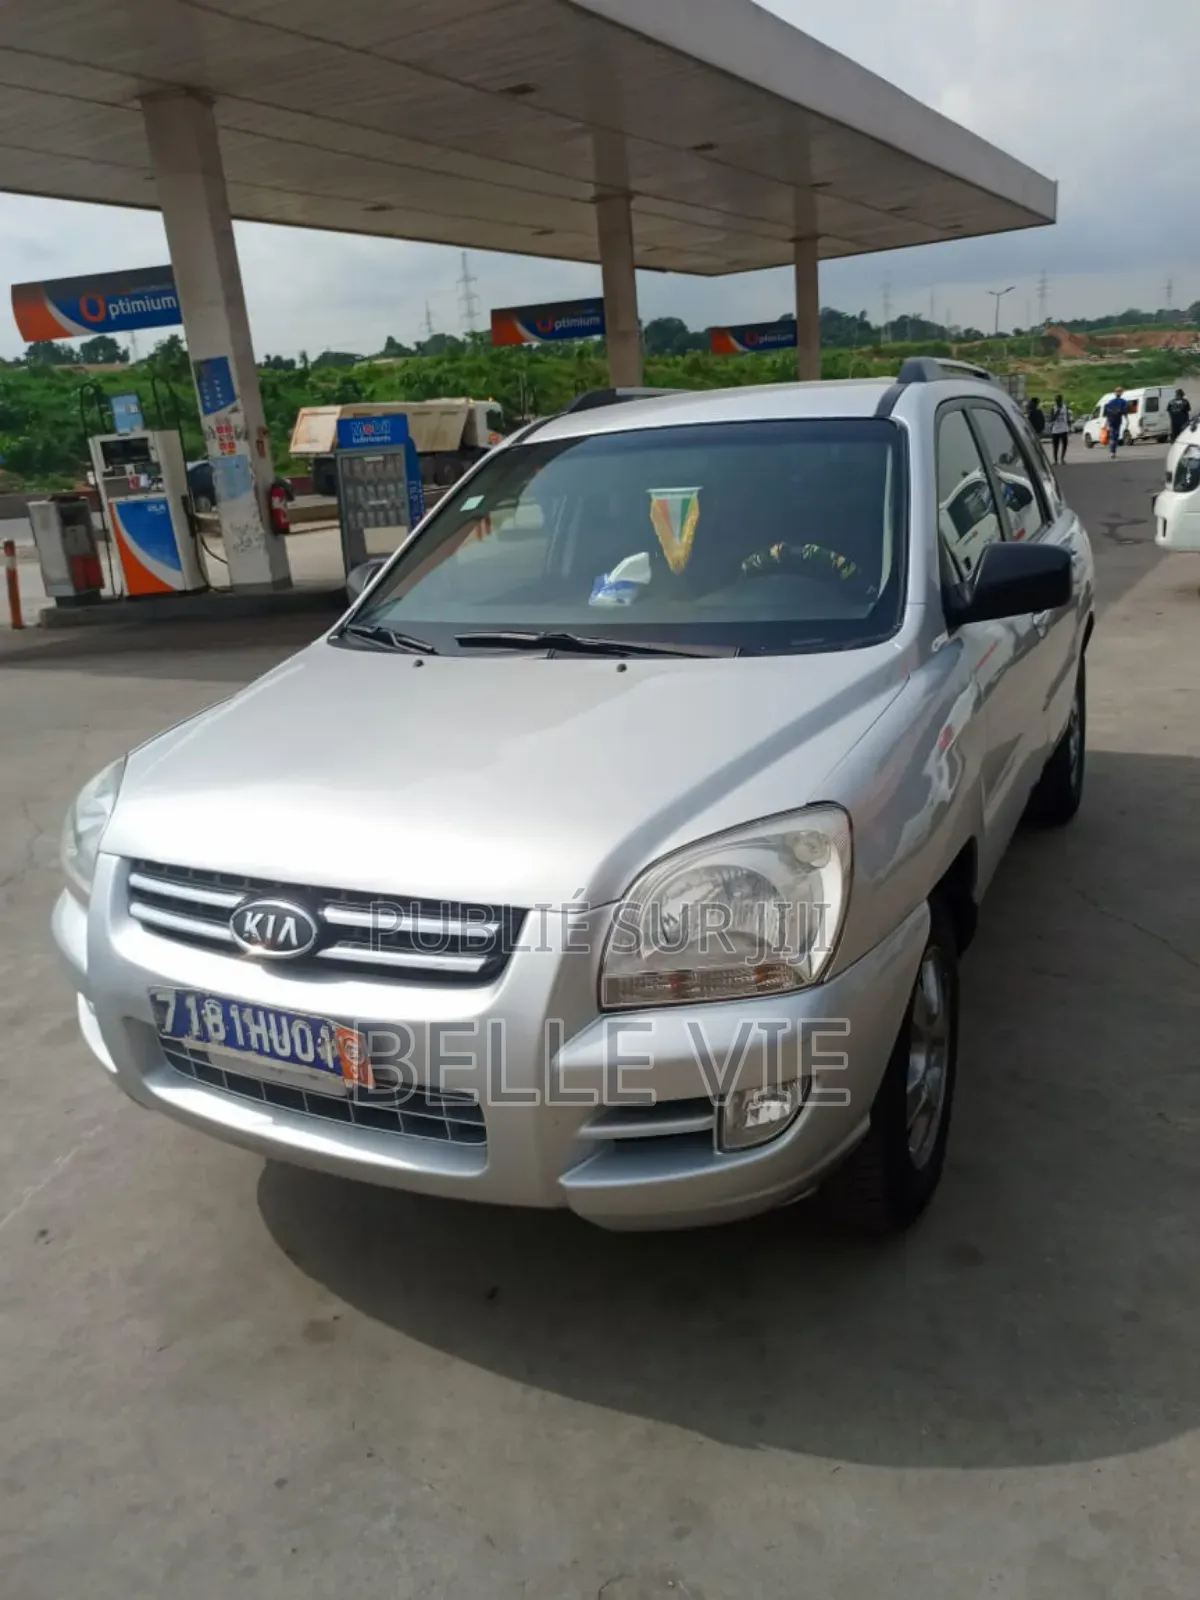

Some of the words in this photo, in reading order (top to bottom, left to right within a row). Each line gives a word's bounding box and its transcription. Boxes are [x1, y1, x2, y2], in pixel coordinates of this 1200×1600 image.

[79, 292, 177, 322] Optimium
[536, 314, 601, 334] Optimium
[243, 911, 298, 946] KIA
